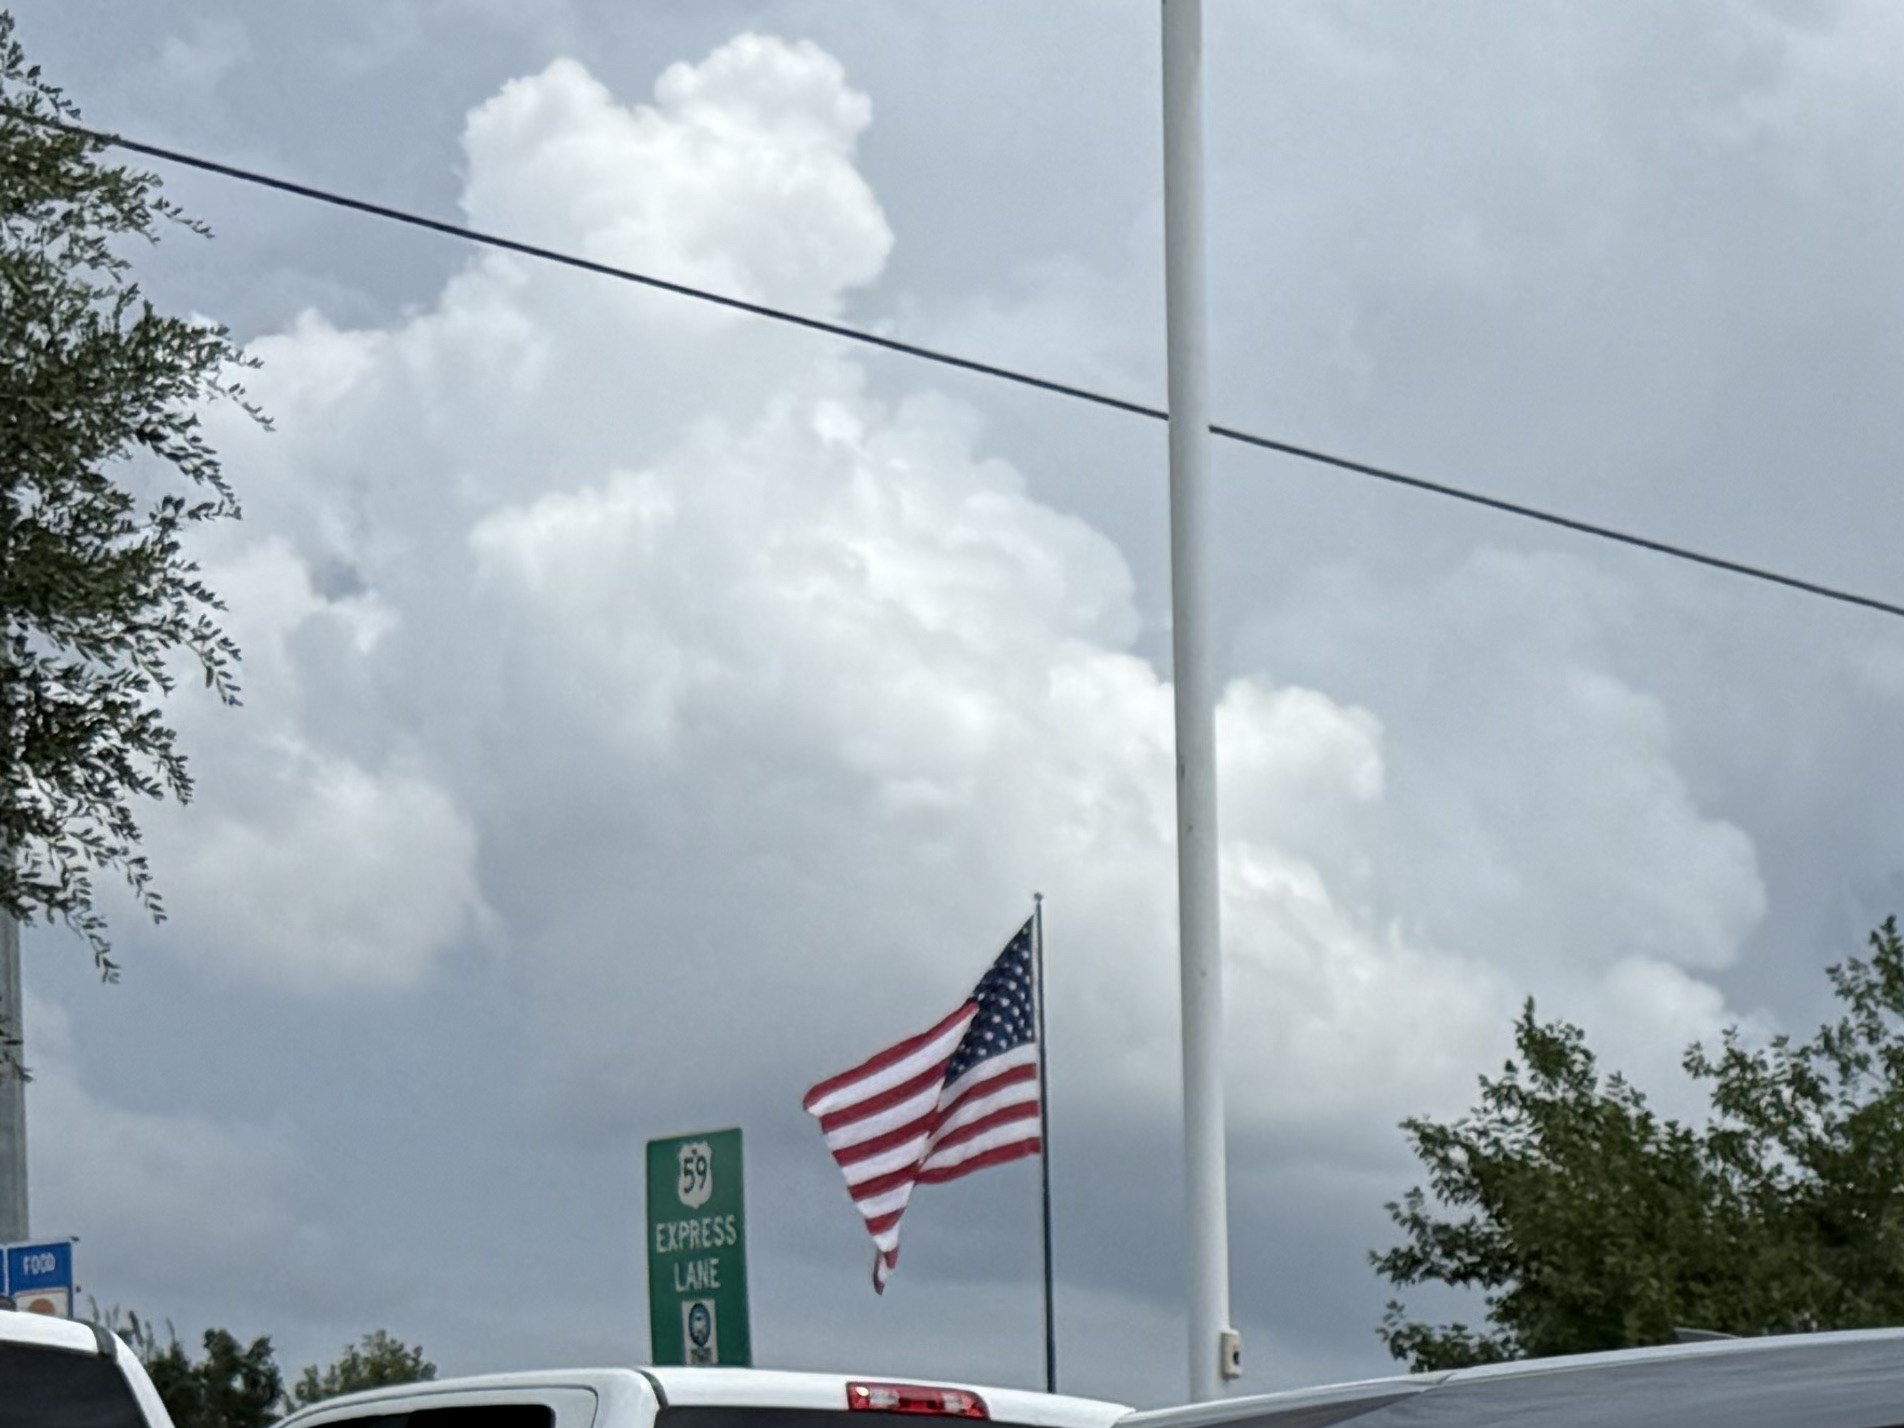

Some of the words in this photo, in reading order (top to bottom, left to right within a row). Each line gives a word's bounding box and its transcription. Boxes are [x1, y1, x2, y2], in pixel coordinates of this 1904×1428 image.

[683, 1155, 708, 1194] 59
[655, 1214, 737, 1253] EXPRESS
[23, 1252, 56, 1275] FOOD
[674, 1258, 721, 1292] LANE
